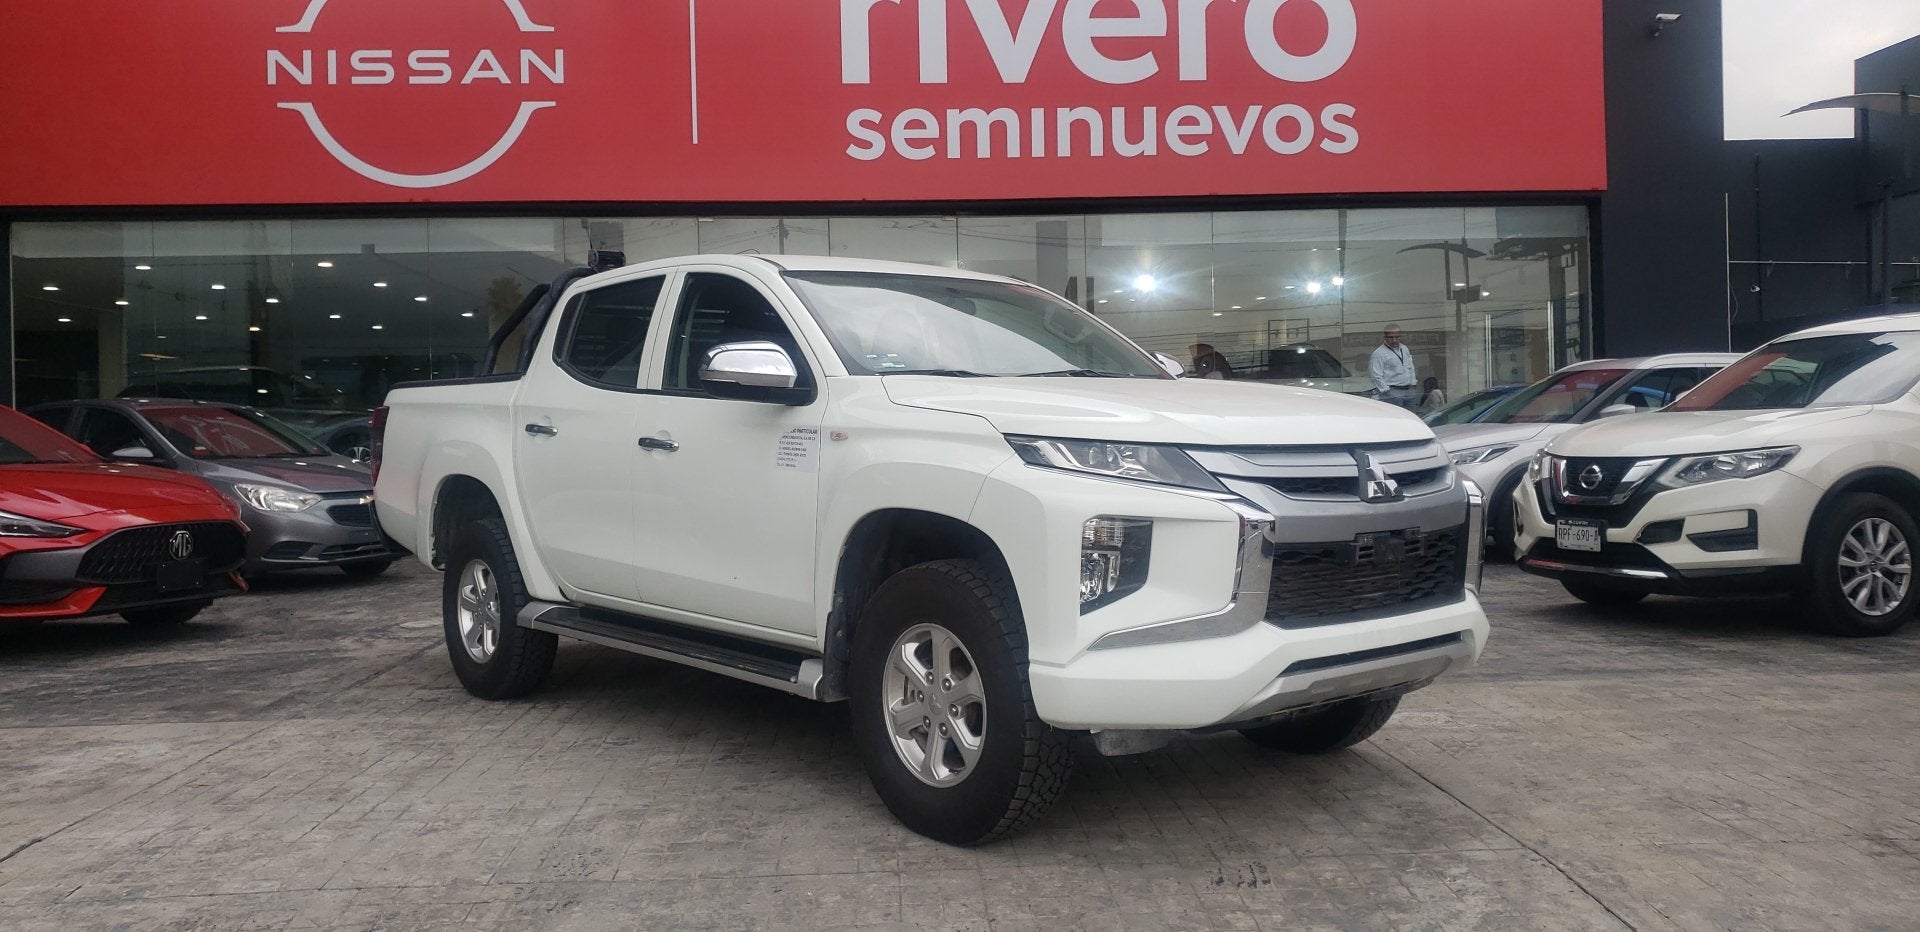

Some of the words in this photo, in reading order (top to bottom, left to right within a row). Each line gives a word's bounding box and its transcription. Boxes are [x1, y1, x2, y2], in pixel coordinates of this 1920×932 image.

[840, 0, 1357, 84] rivero
[267, 49, 564, 85] NISSAN
[846, 103, 1359, 160] seminuevos
[173, 533, 192, 558] MG
